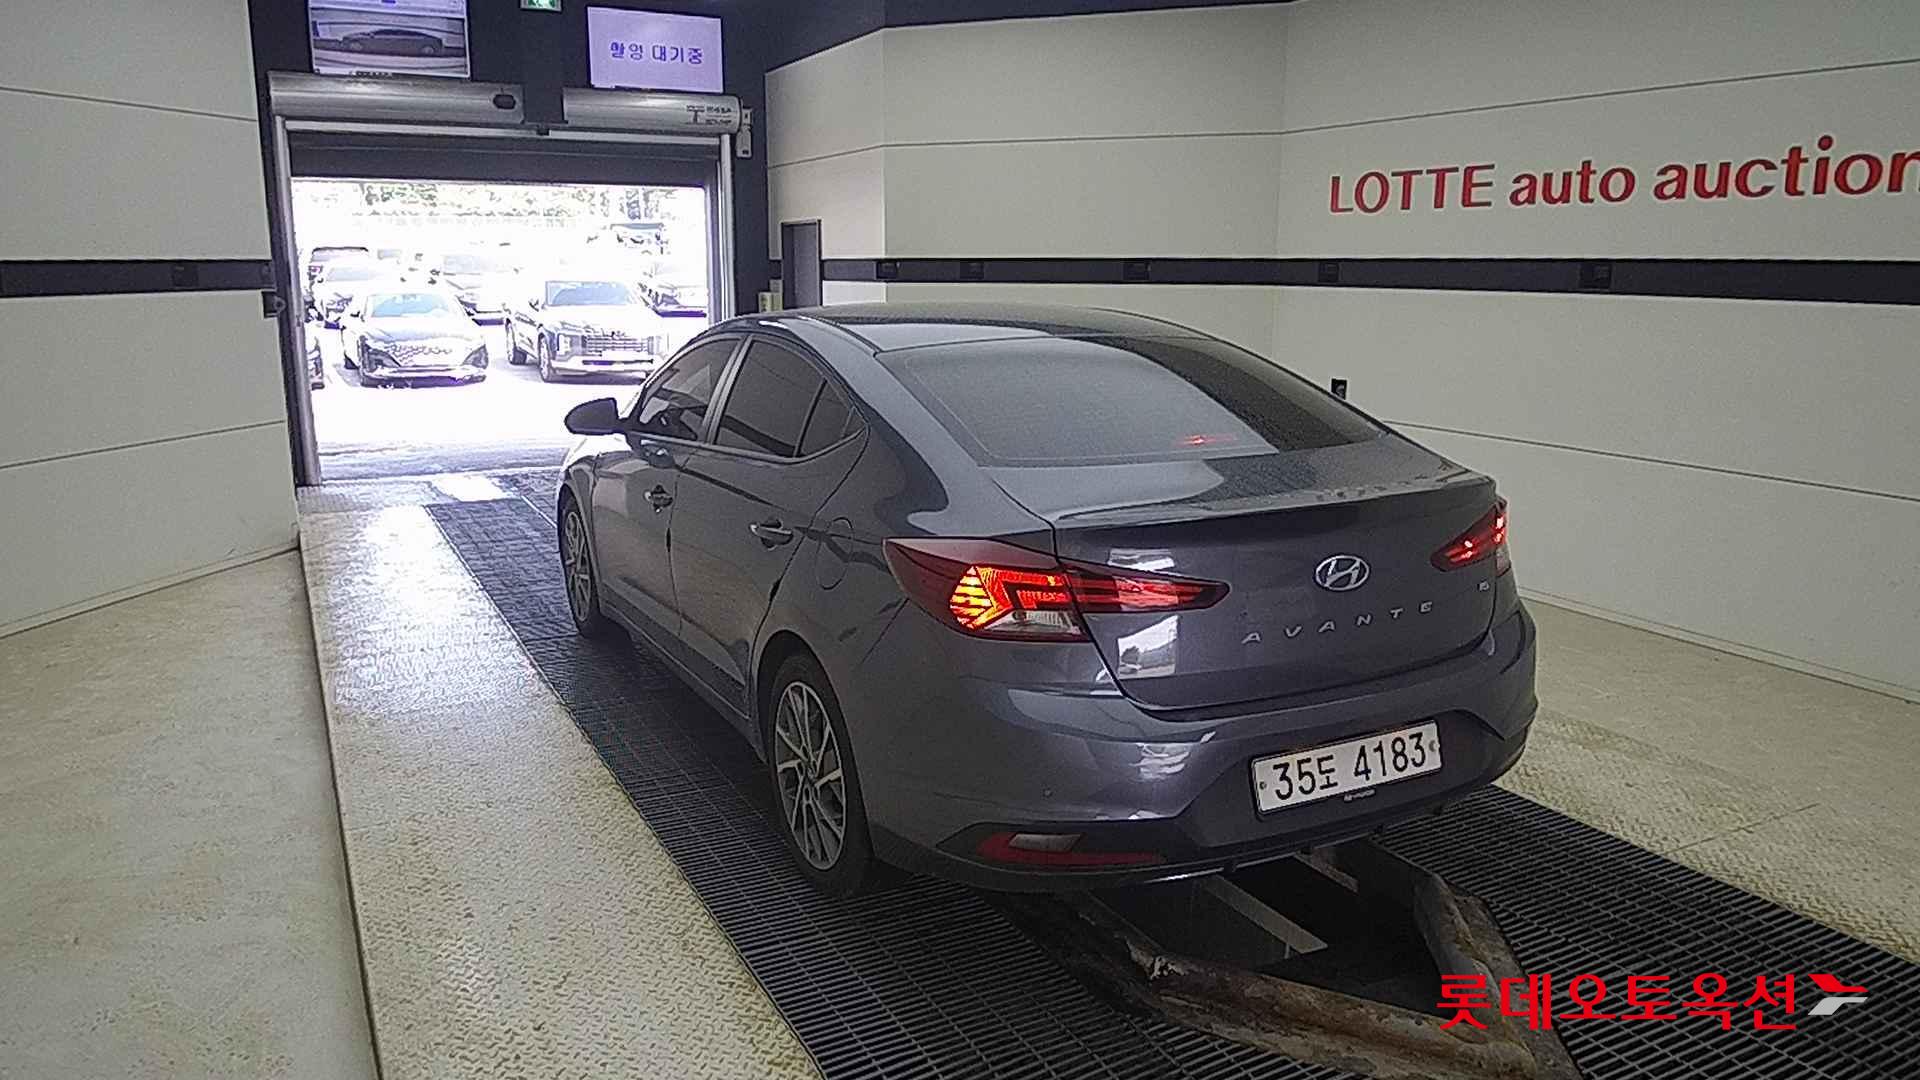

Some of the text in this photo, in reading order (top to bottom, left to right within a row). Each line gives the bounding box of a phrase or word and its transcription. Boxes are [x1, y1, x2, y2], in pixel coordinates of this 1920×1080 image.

[652, 44, 702, 65] 대기중
[1330, 163, 1496, 214] LOTTE
[1509, 160, 1636, 206] auto
[1241, 600, 1433, 645] AVANTE
[1272, 732, 1426, 800] 35도 4183
